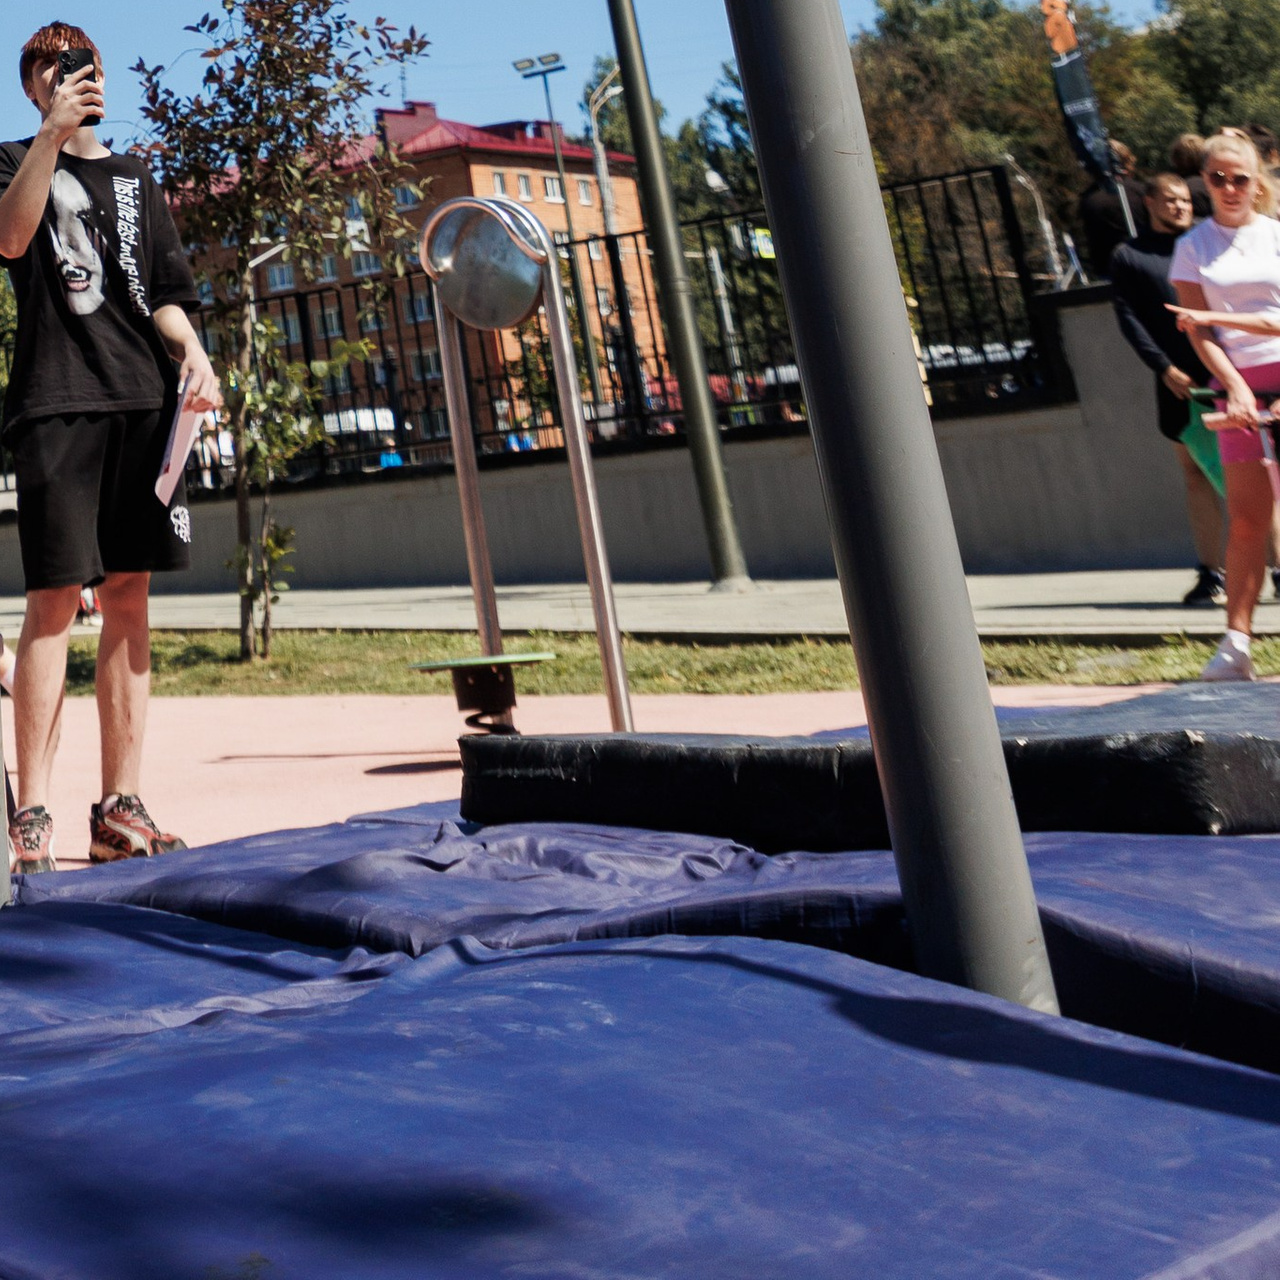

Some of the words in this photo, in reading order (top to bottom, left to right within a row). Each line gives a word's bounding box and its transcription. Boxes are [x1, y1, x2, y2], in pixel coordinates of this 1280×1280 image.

[112, 176, 140, 196] This
[117, 202, 140, 223] the
[116, 219, 140, 246] last
